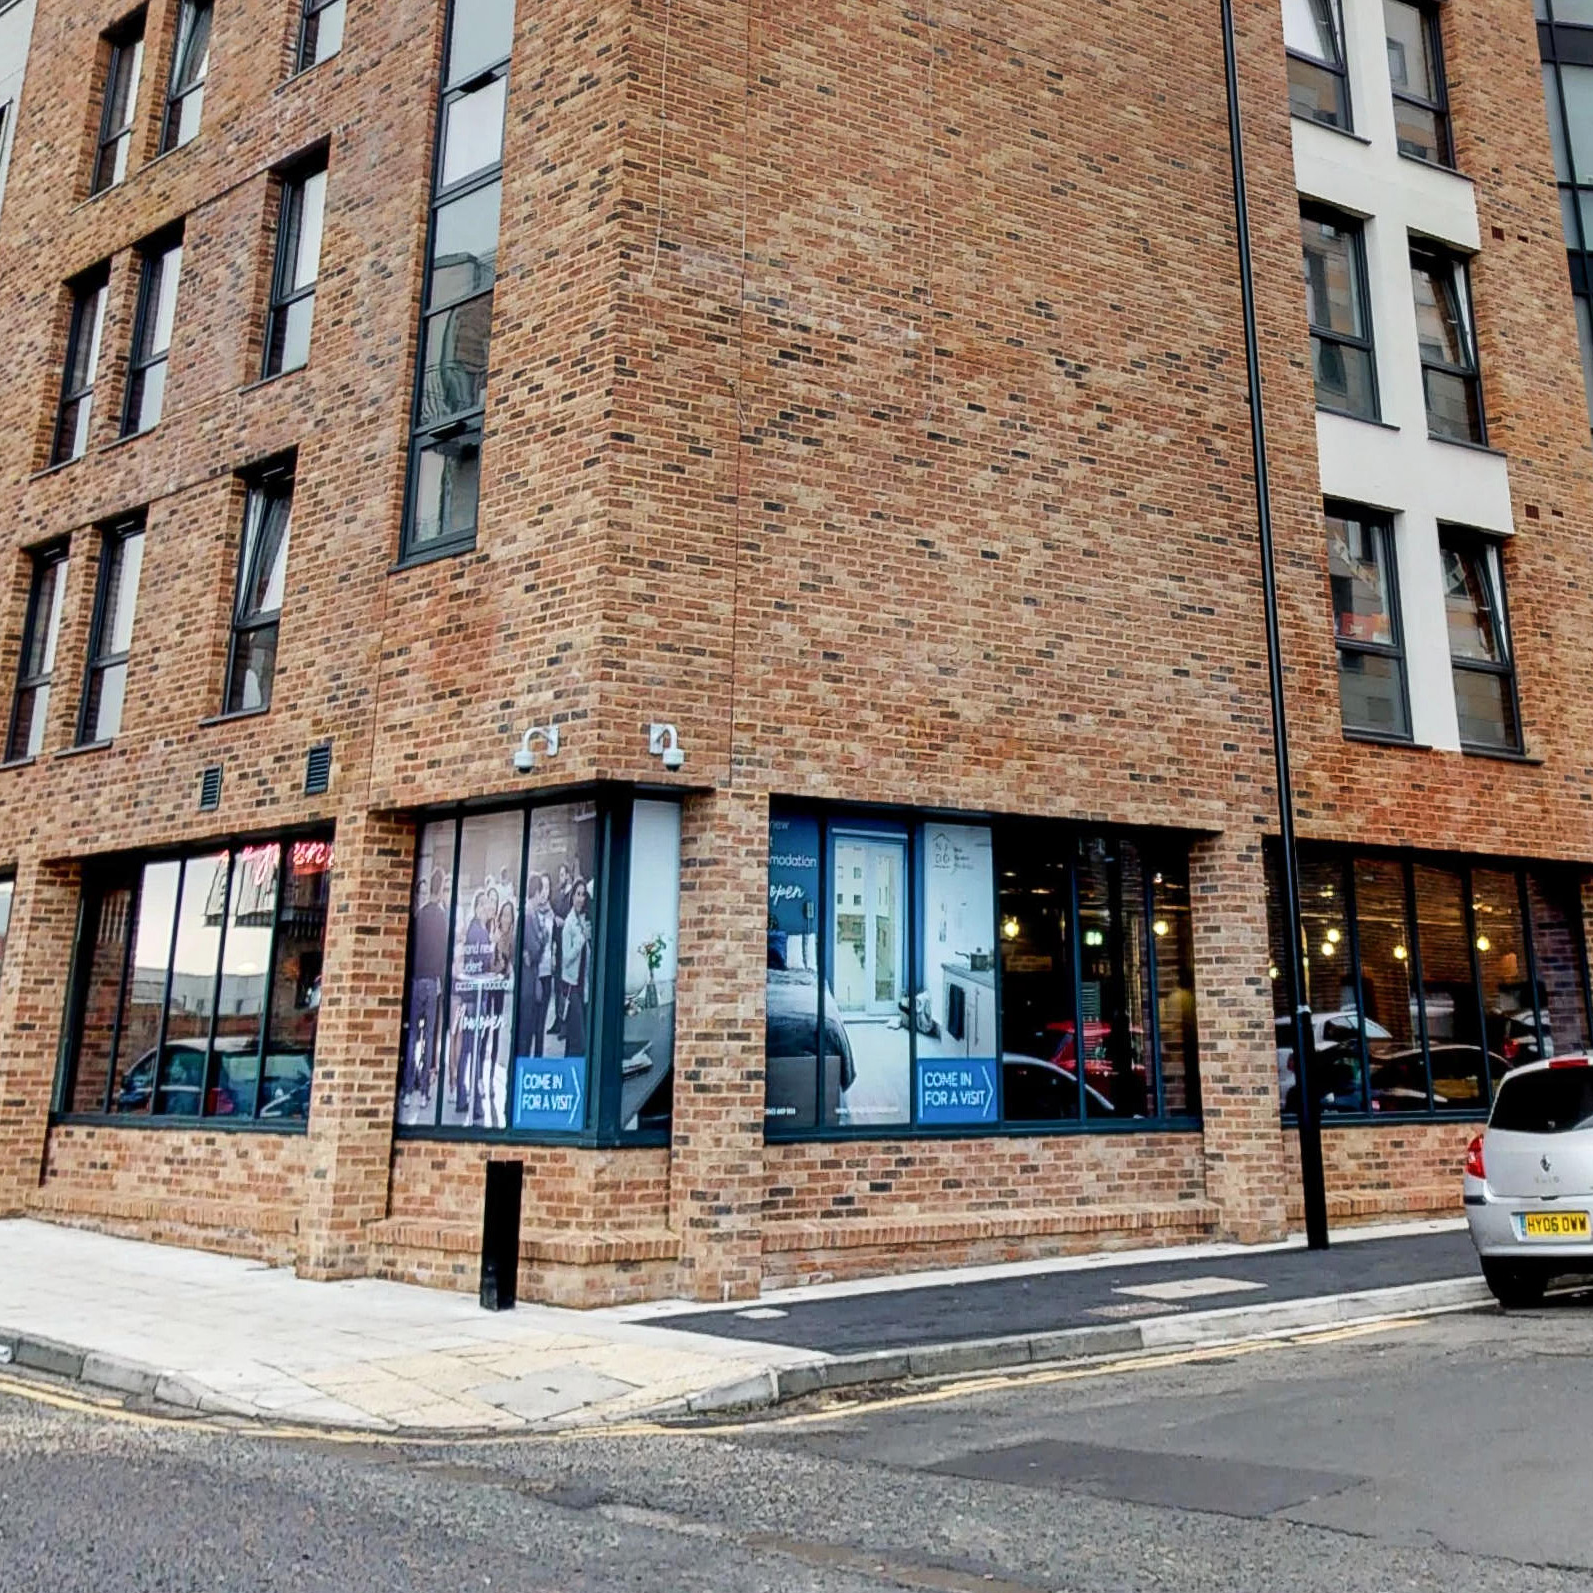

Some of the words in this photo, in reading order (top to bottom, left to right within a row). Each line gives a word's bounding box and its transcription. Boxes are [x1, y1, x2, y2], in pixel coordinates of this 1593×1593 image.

[523, 1073, 552, 1090] COME
[552, 1073, 563, 1090] IN
[924, 1071, 958, 1088] COME
[960, 1071, 972, 1088] IN
[522, 1093, 542, 1111] FOR
[542, 1094, 550, 1111] A
[551, 1094, 574, 1111] VISIT
[924, 1090, 948, 1107] FOR
[950, 1090, 959, 1106] A
[960, 1089, 986, 1106] VISIT
[1527, 1215, 1560, 1233] HY06
